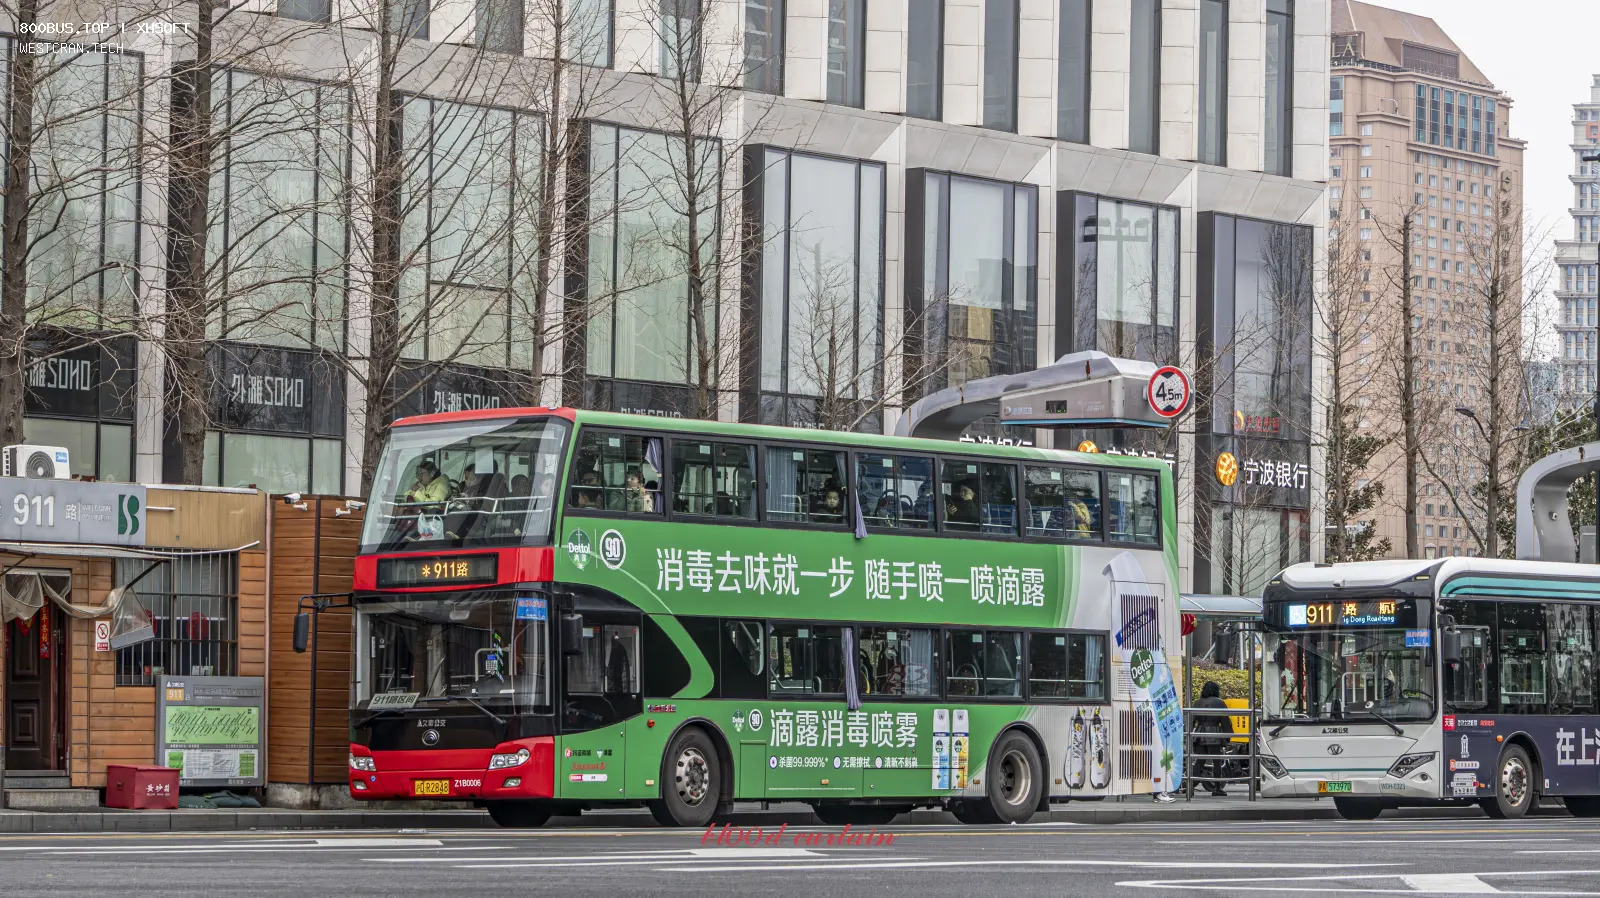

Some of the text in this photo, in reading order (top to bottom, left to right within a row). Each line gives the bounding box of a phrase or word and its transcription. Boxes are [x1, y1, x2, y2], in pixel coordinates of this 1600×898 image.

[1156, 382, 1183, 402] 4.5m
[1243, 458, 1309, 489] 宁波银行
[13, 493, 55, 527] 911
[568, 537, 621, 558] Dettol 90
[656, 547, 1046, 607] 消毒去味就一步 随手喷一喷滴露
[1306, 604, 1333, 624] 911
[1131, 655, 1154, 680] Dettol
[751, 713, 760, 725] 90
[770, 708, 919, 748] 滴露消毒喷雾
